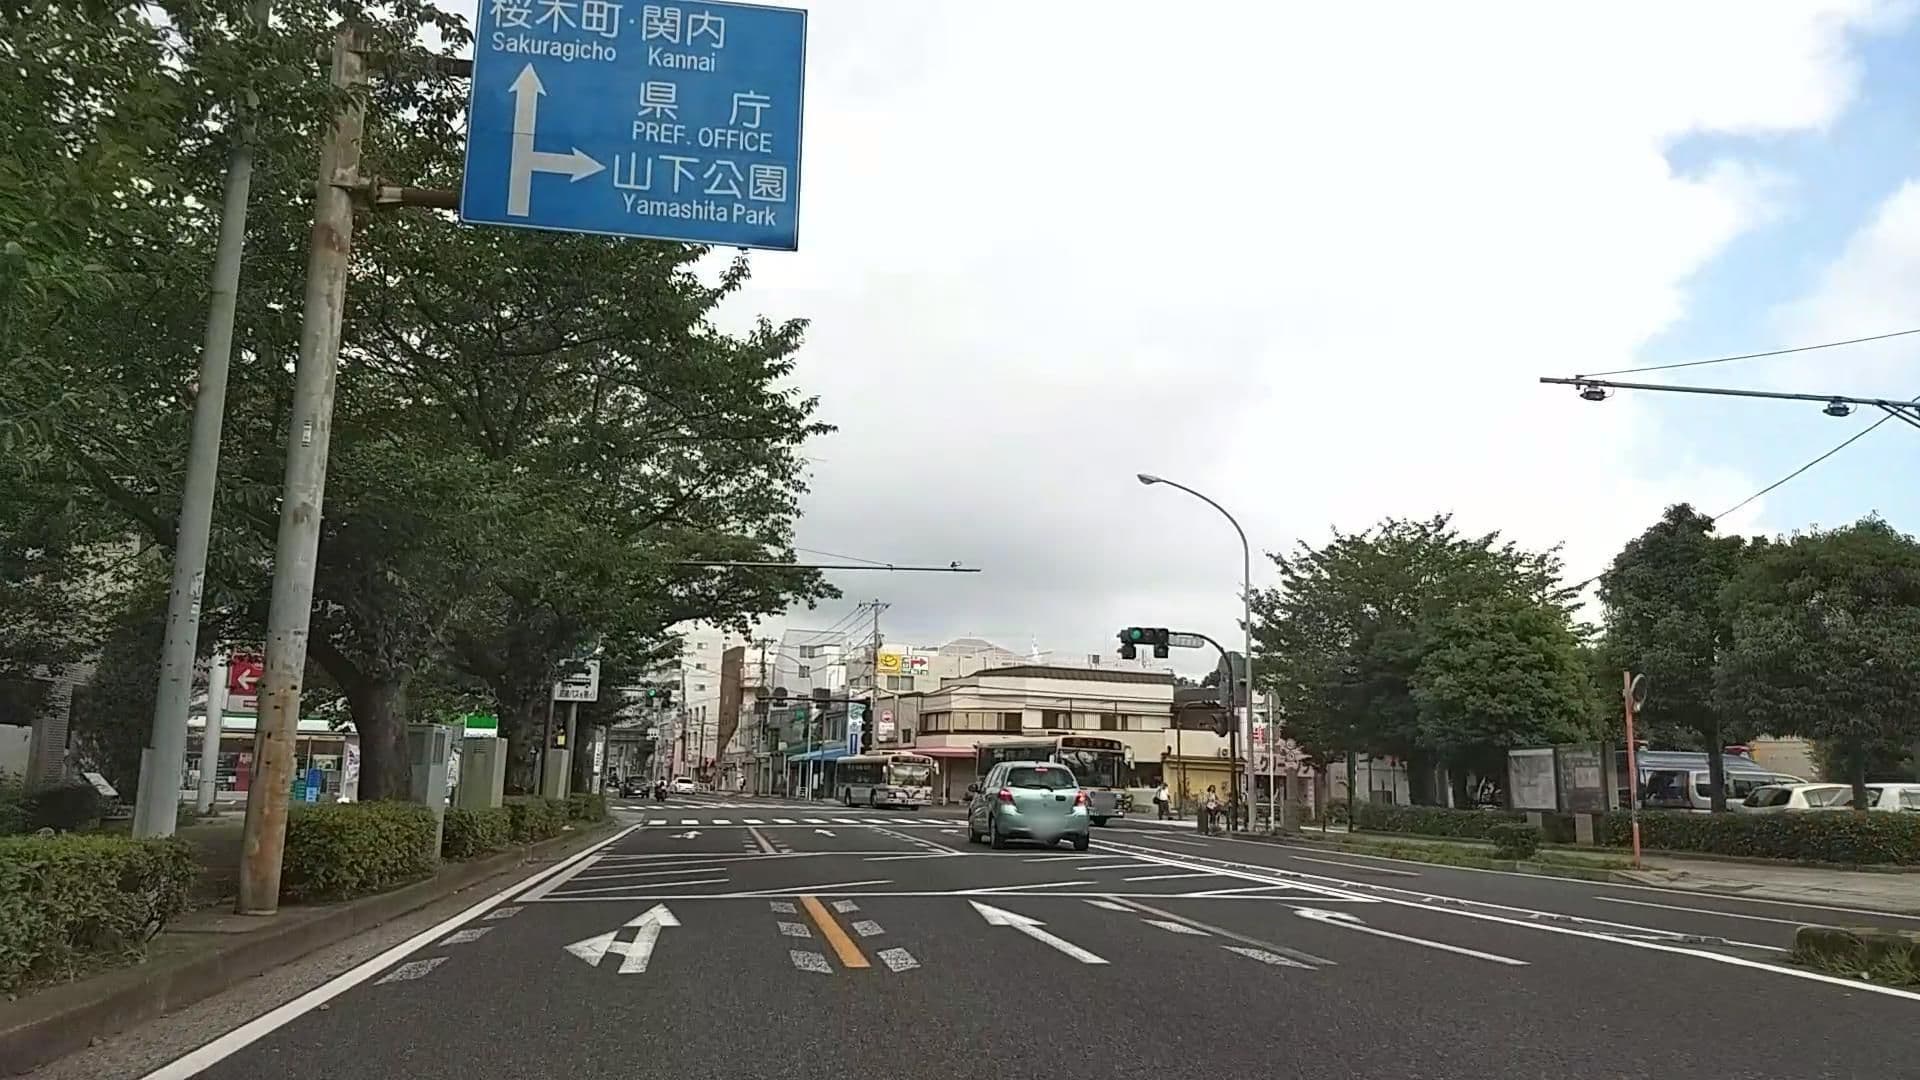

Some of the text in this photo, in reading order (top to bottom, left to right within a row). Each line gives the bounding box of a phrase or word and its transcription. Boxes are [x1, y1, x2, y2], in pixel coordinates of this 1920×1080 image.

[491, 31, 717, 73] Sakuragicho Kannai
[632, 120, 773, 153] PREF. OFFICE
[613, 152, 787, 202] 山下公園
[623, 192, 777, 227] Yamashita Park
